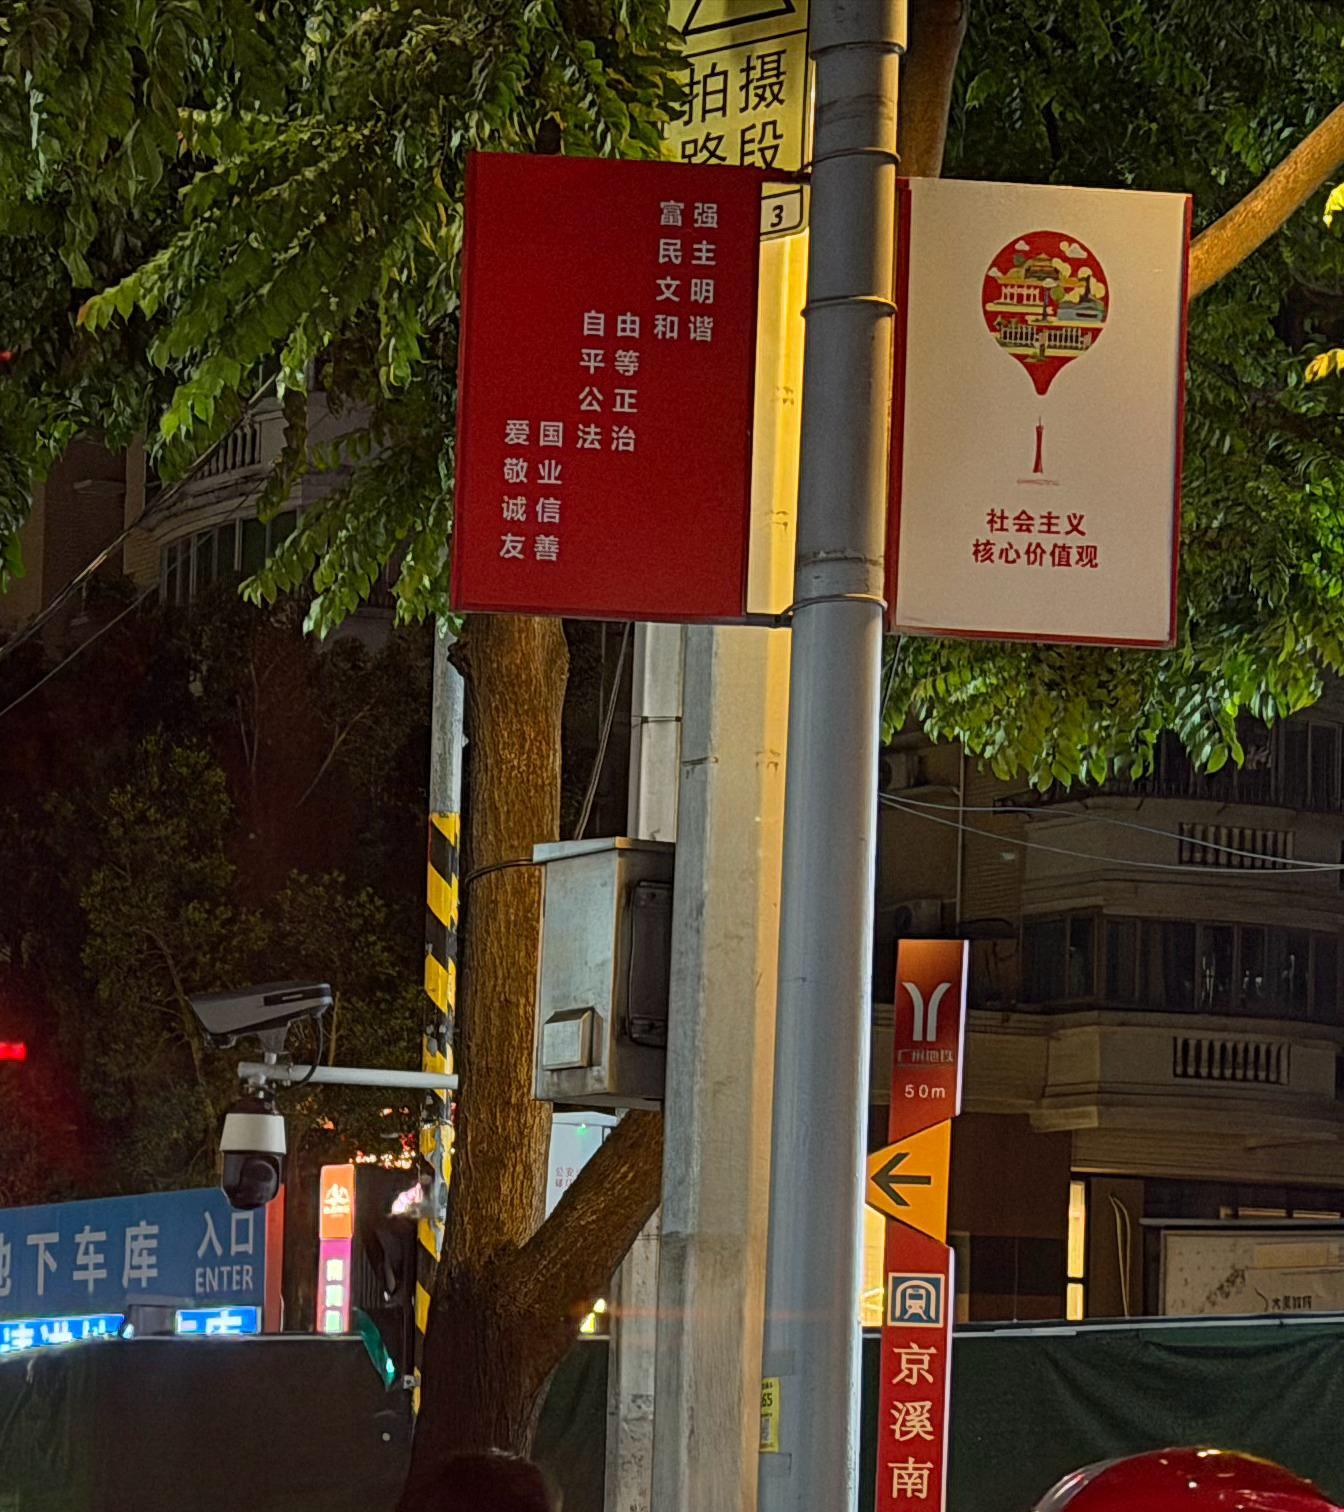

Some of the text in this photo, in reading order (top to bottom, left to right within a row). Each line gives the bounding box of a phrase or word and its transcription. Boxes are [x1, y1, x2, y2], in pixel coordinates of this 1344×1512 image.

[679, 49, 787, 126] 拍摄
[659, 200, 718, 228] 富强
[658, 239, 716, 265] 民主
[656, 276, 715, 304] 文明
[582, 310, 640, 338] 自由
[654, 314, 713, 342] 和谐
[579, 349, 639, 376] 平等
[578, 386, 638, 413] 公正
[505, 420, 563, 447] 爱国
[576, 424, 636, 451] 法治
[503, 458, 562, 485] 敬业
[501, 496, 561, 523] 诚信
[986, 508, 1086, 536] 社会主义
[499, 533, 560, 561] 友善
[972, 538, 1099, 569] 核心价值观
[197, 1211, 255, 1259] 入口
[195, 1265, 254, 1293] ENTER
